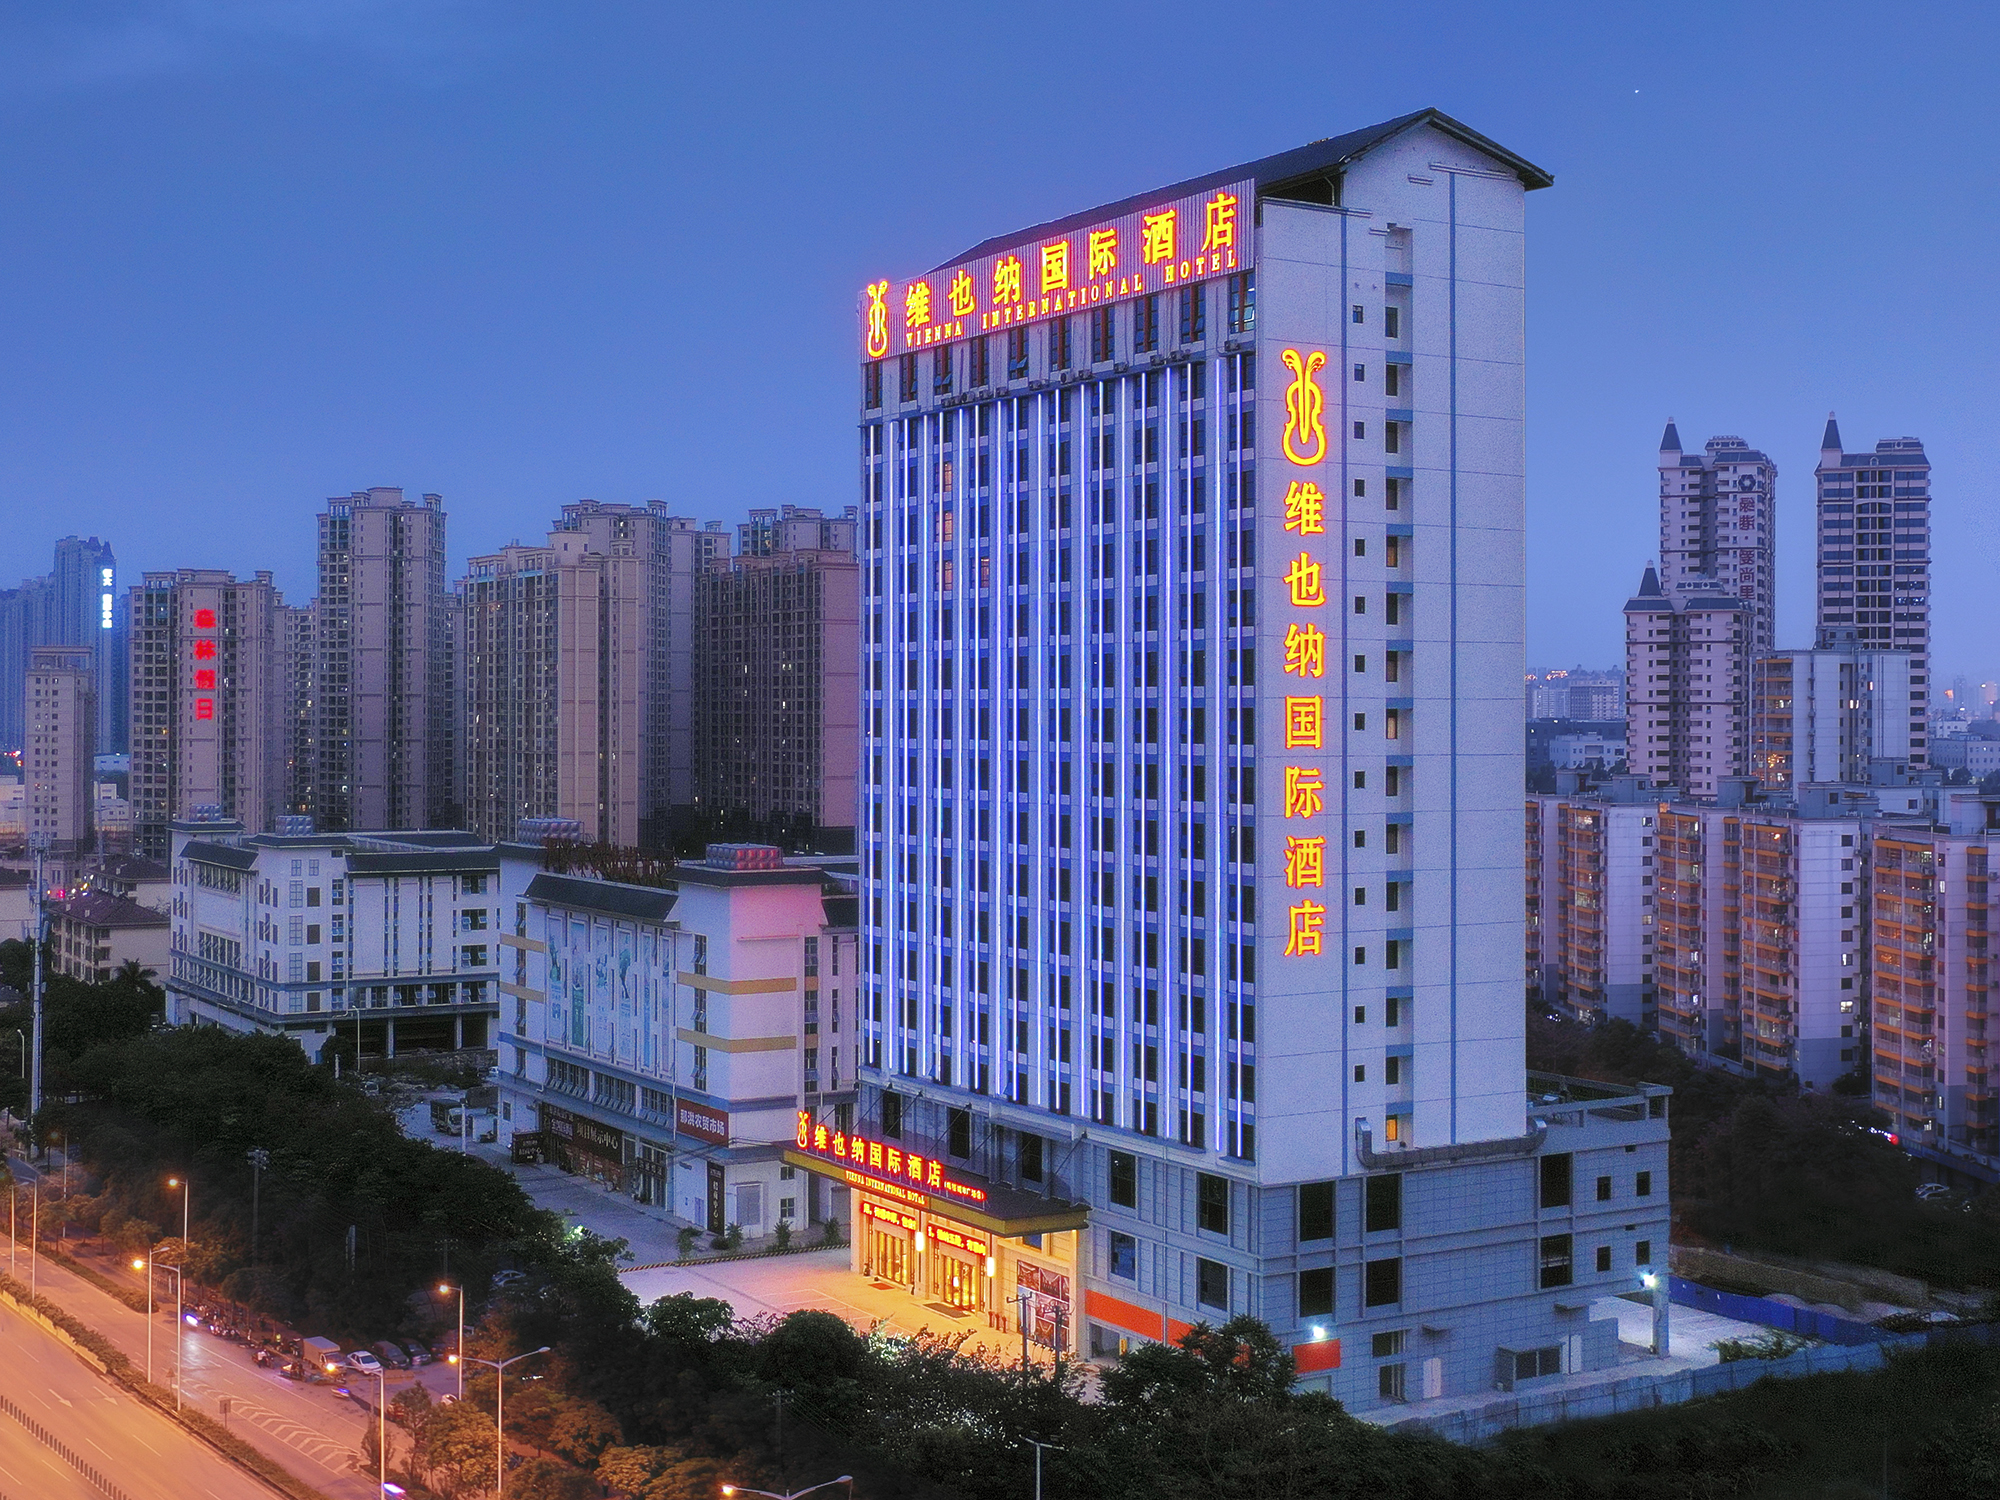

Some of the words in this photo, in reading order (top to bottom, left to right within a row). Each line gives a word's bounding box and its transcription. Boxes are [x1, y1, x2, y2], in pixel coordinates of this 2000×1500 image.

[904, 193, 1238, 328] 维也纳国际酒店
[905, 325, 963, 349] VIENNA
[981, 273, 1144, 331] INTERNATIONAL
[1164, 247, 1237, 284] HOTEL
[1283, 480, 1328, 956] 维也纳国际酒店
[814, 1124, 943, 1188] 维也纳国际酒店
[845, 1170, 865, 1185] VIENNA
[865, 1177, 906, 1199] INTERNATIONAL
